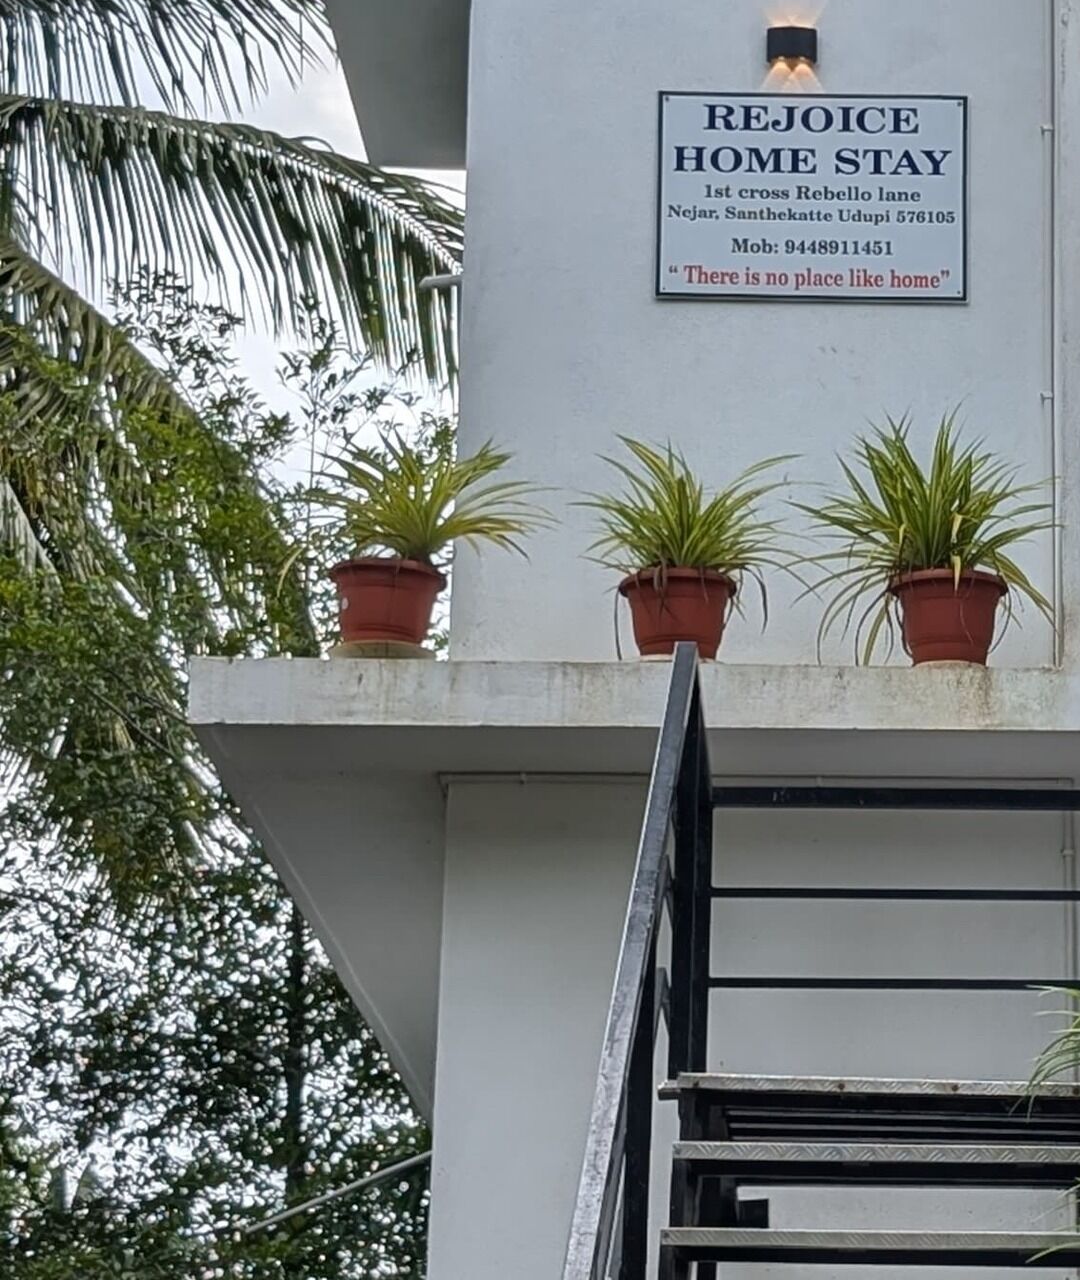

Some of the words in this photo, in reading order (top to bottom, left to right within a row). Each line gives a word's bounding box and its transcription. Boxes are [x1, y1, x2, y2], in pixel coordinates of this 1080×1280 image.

[703, 104, 919, 134] REJOICE
[674, 146, 817, 174] HOME
[835, 148, 952, 176] STAY
[704, 184, 732, 199] 1st
[738, 188, 790, 200] cross
[796, 185, 872, 201] Rebello
[878, 187, 921, 202] lane
[725, 206, 833, 222] Santhekatte
[838, 209, 890, 226] Udupi
[896, 211, 956, 224] 576105
[731, 238, 779, 254] Mob:
[785, 239, 894, 256] 9448911451
[745, 267, 760, 286] is
[766, 272, 788, 287] no
[795, 268, 844, 290] place
[849, 269, 884, 287] like
